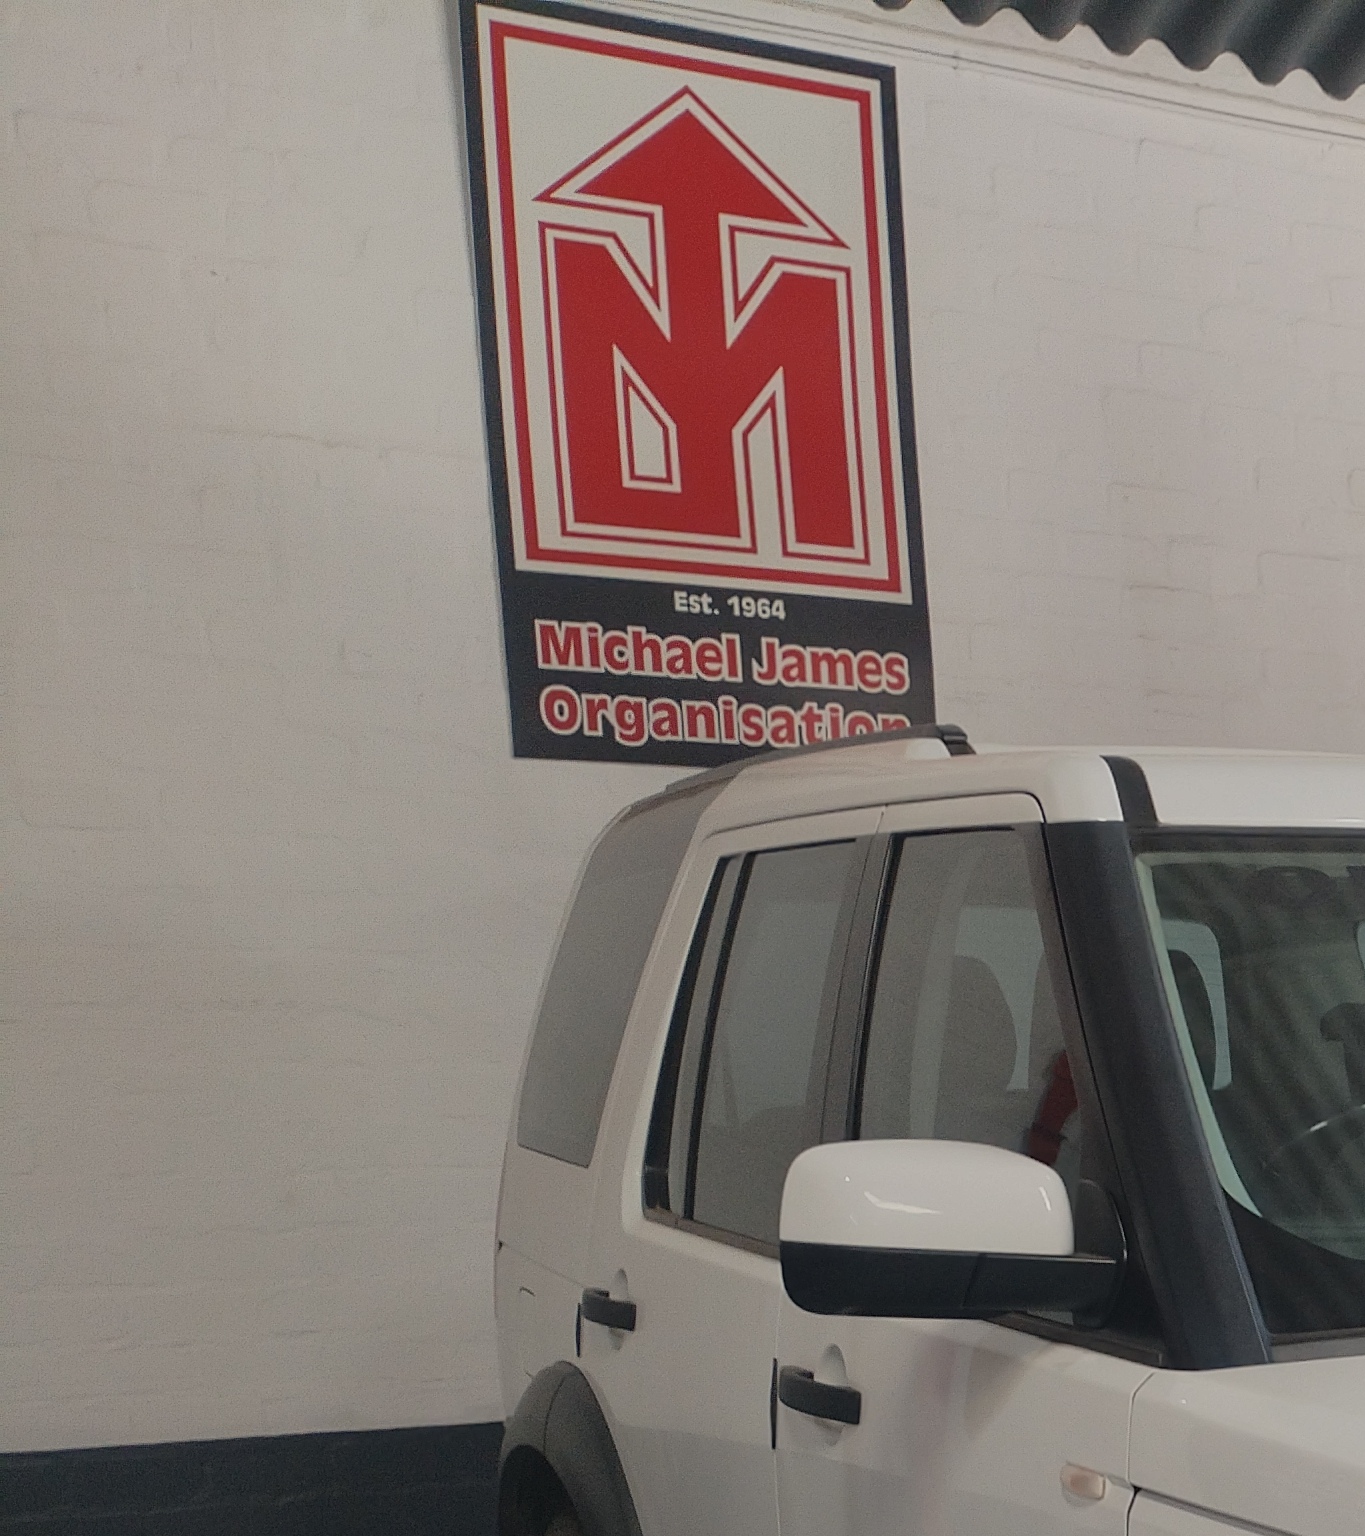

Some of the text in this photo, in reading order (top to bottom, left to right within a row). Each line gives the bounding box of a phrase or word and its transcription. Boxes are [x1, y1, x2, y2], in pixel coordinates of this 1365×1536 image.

[673, 589, 787, 621] Est. 1964
[534, 619, 910, 695] Michael James
